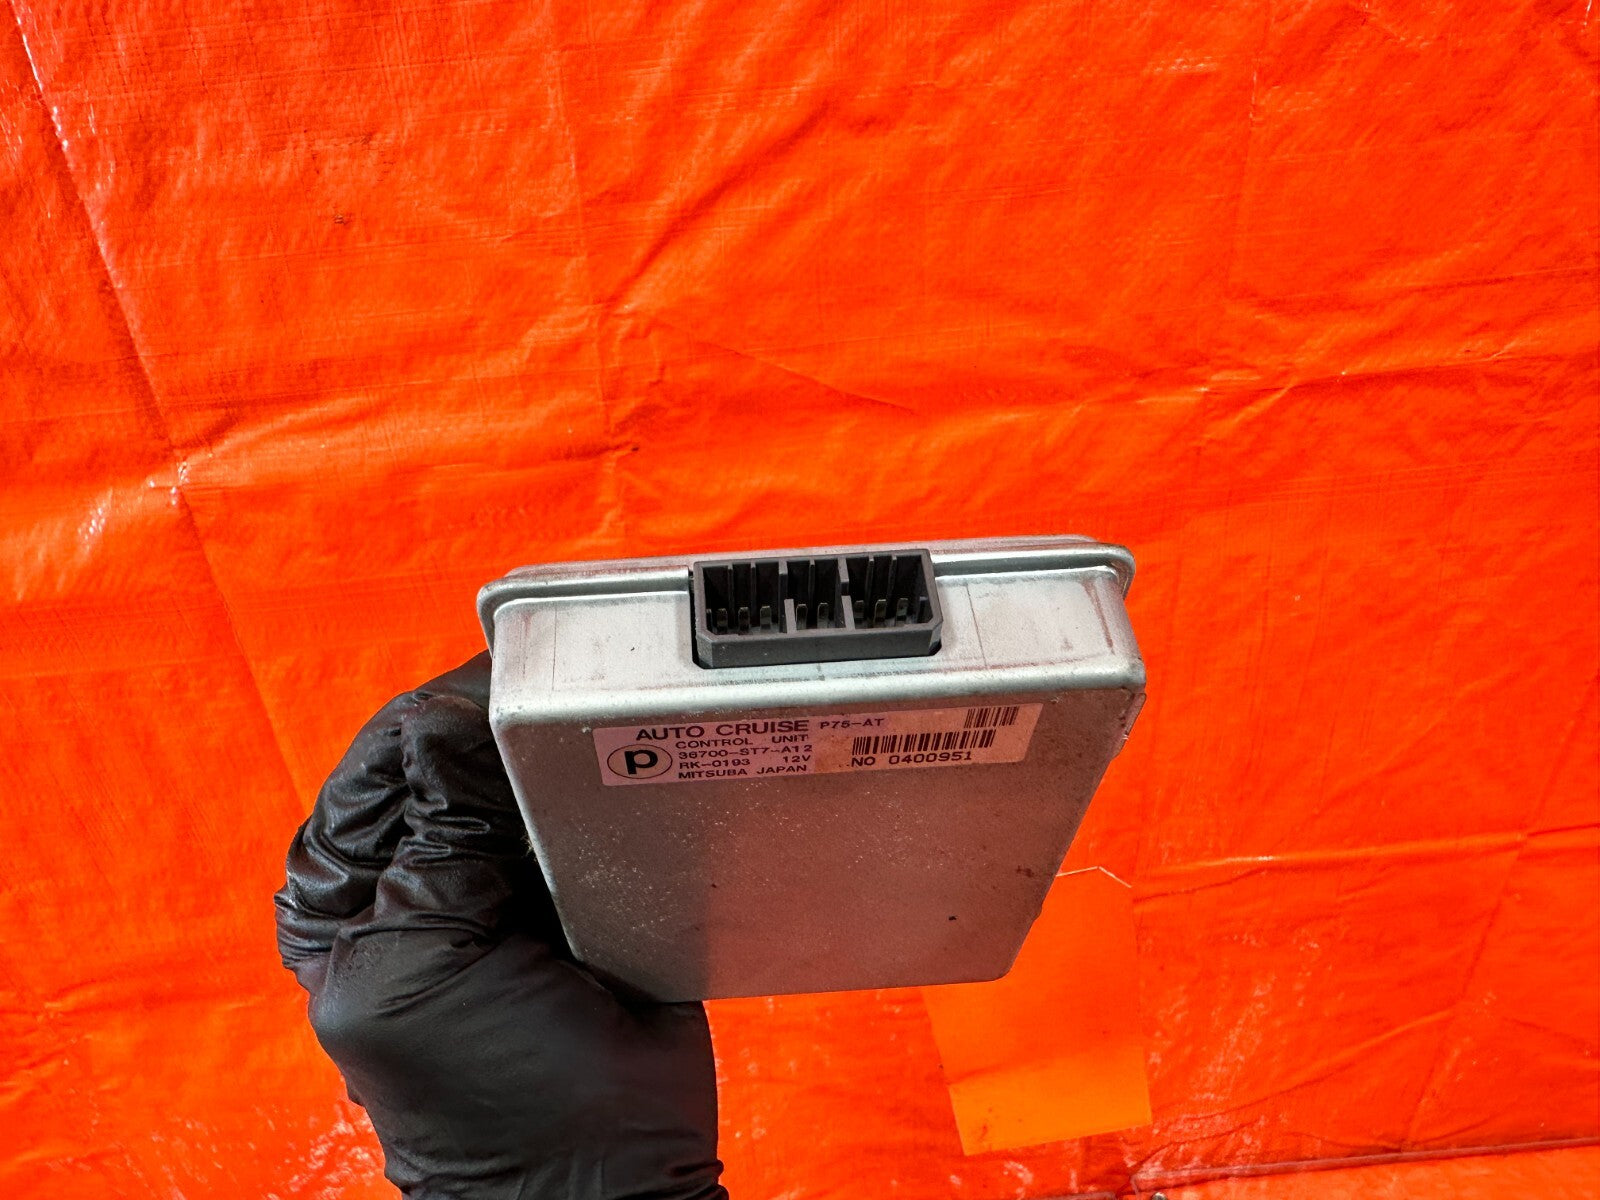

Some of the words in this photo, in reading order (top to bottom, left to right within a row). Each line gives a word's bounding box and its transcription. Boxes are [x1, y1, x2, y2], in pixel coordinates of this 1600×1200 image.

[636, 725, 705, 741] AUTO
[716, 719, 810, 735] CRUISE
[819, 718, 885, 729] P75-AT
[675, 737, 753, 749] CONTROL
[771, 734, 809, 744] UNIT
[783, 754, 811, 764] 12V
[851, 756, 876, 767] NO
[888, 751, 973, 765] 0400951
[678, 768, 748, 779] MITSUBA
[756, 764, 807, 775] JAPAN
